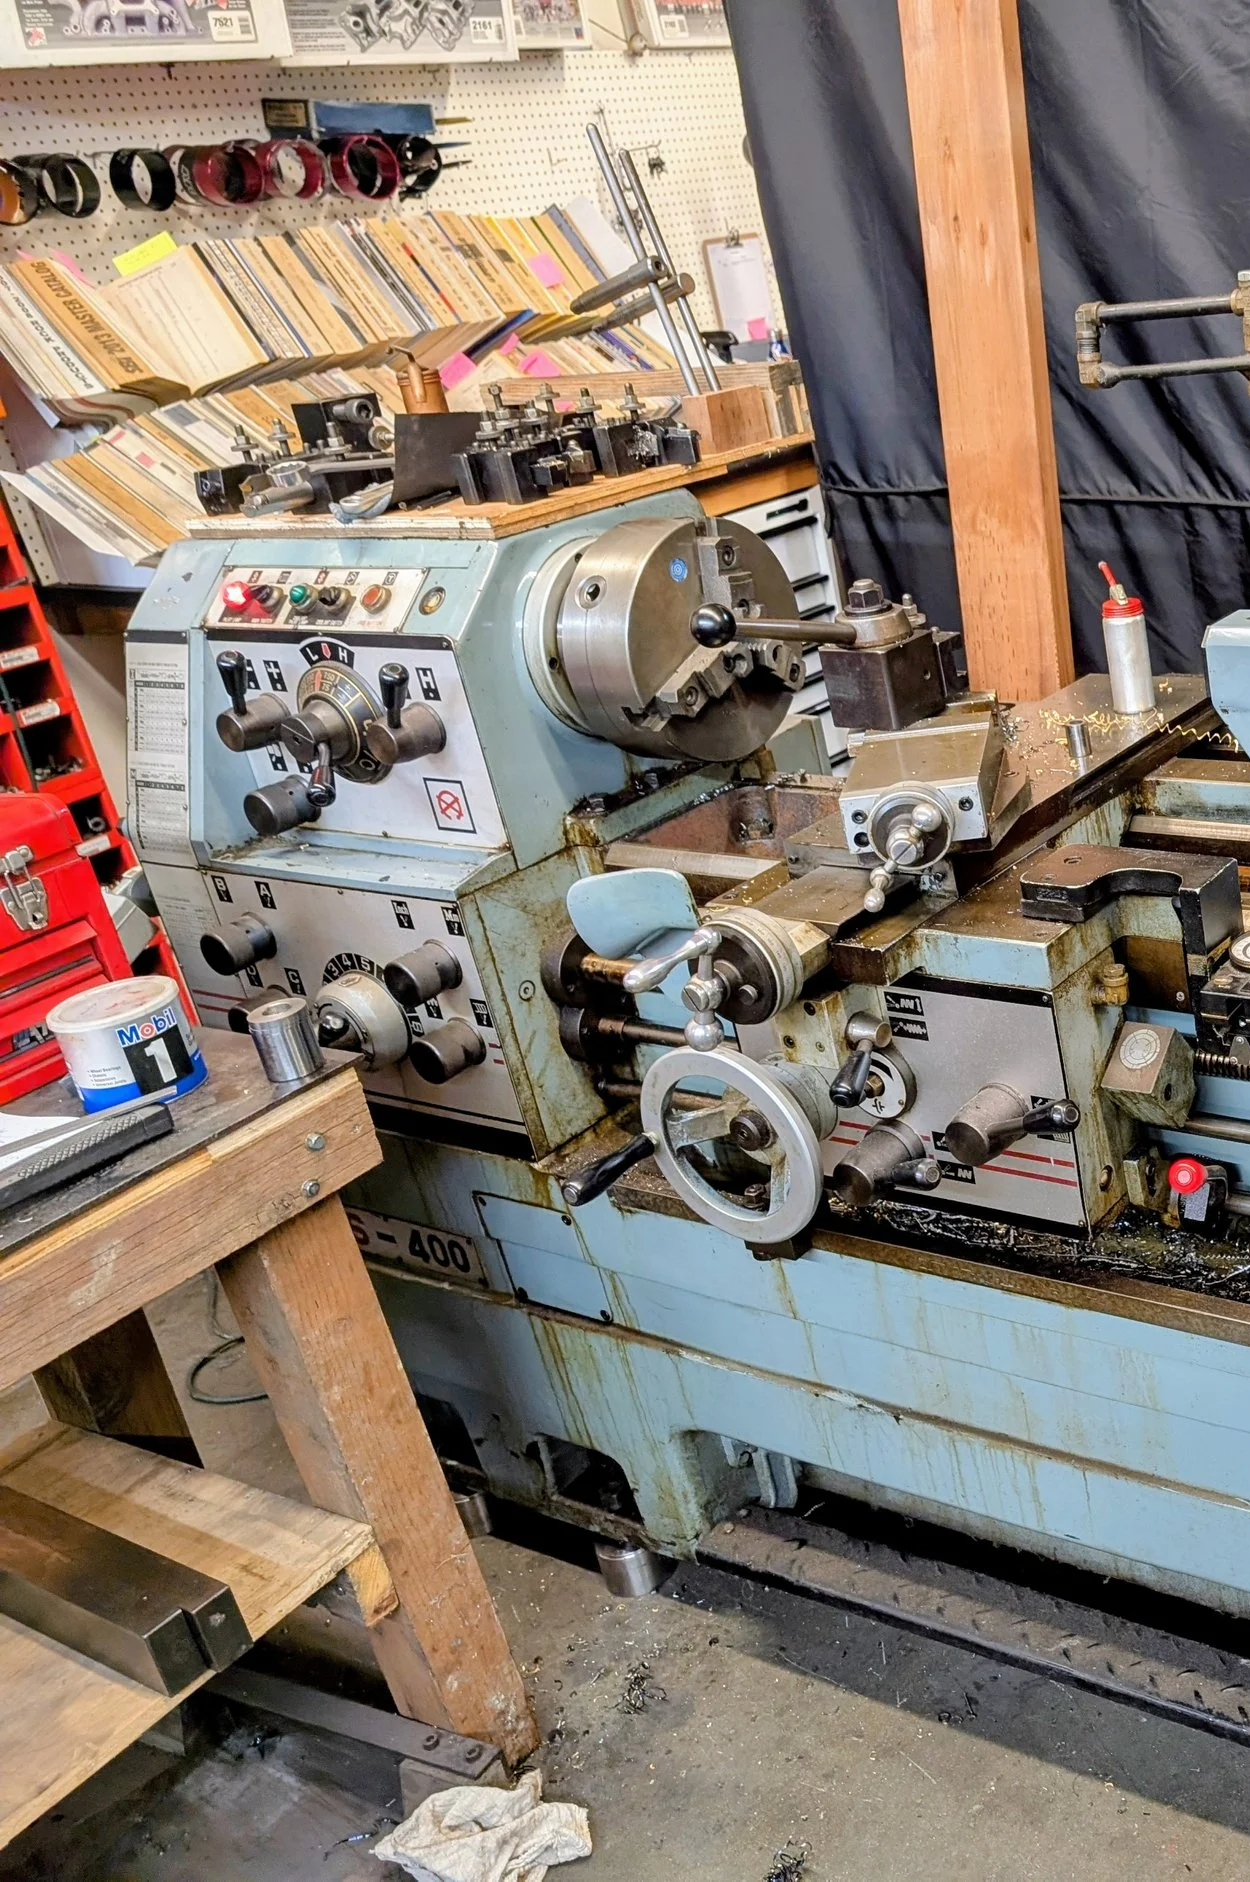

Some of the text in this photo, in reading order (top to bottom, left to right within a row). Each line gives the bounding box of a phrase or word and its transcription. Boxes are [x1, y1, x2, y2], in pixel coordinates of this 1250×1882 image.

[212, 16, 233, 28] 7521
[472, 20, 492, 30] 2161
[30, 260, 73, 299] CATALOG
[62, 298, 105, 335] MASTER
[94, 330, 126, 355] 2013
[217, 879, 227, 892] B
[259, 883, 271, 898] A
[342, 953, 352, 968] 4
[360, 957, 371, 972] 5
[116, 1007, 177, 1047] Mobil
[144, 1037, 178, 1084] 1
[409, 1229, 471, 1273] 400
